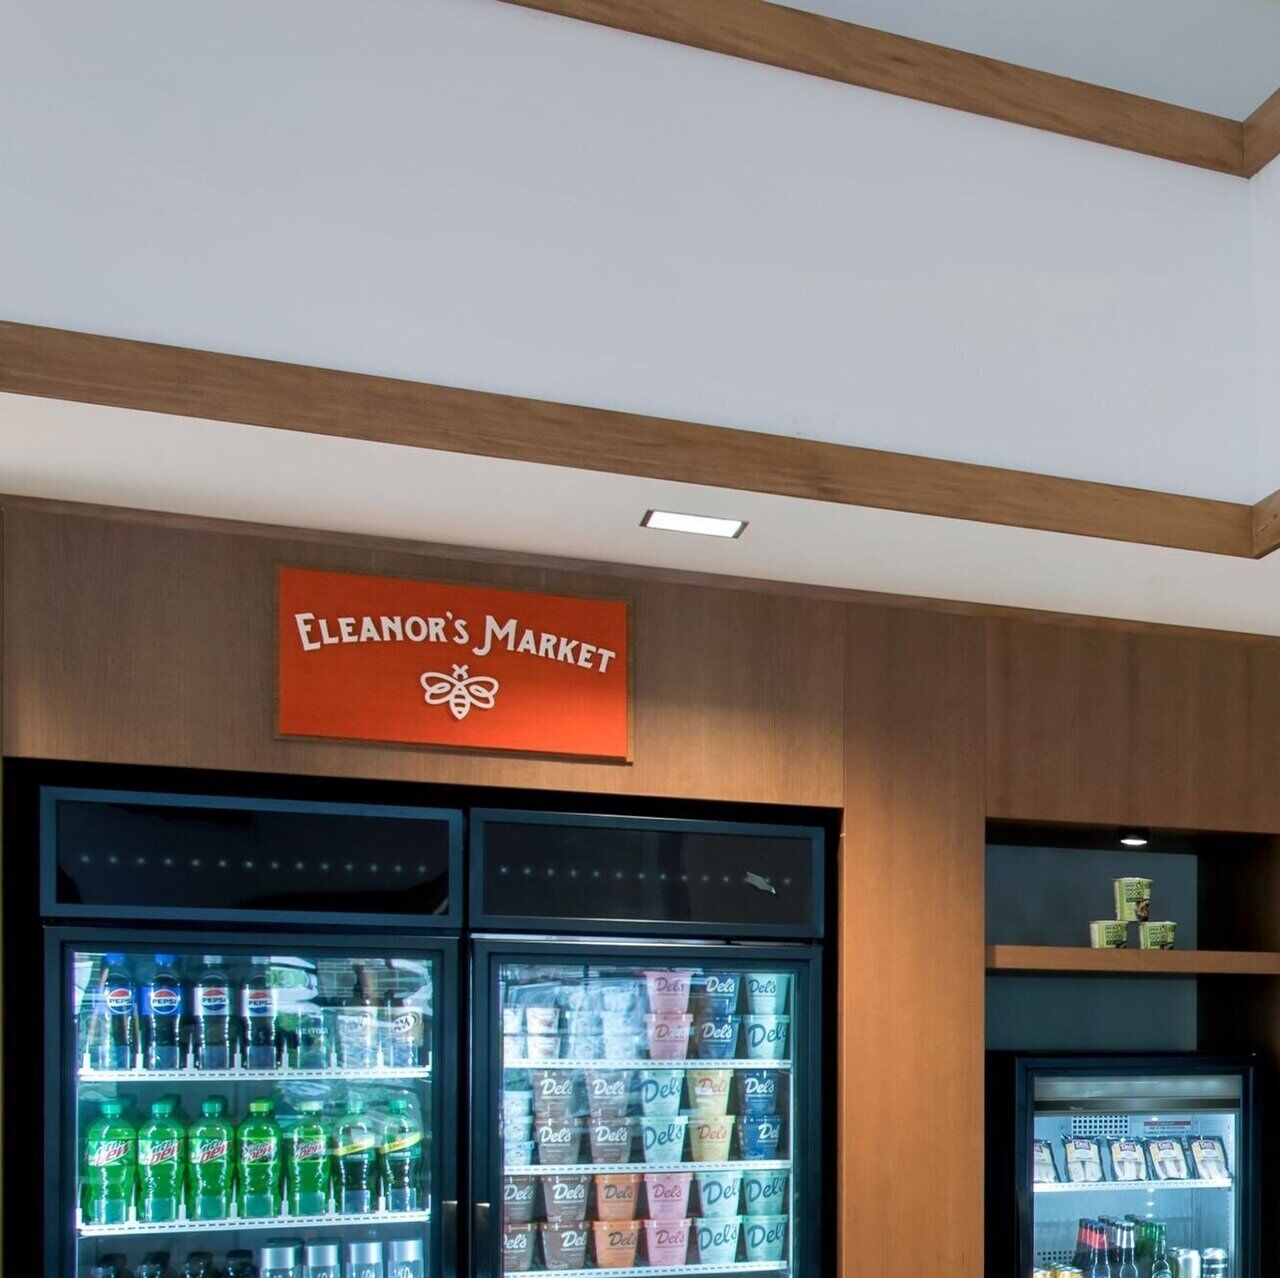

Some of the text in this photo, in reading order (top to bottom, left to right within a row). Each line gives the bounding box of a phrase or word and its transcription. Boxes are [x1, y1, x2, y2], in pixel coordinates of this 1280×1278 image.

[295, 611, 616, 673] ELEANOR'S MARKET
[706, 976, 734, 992] Del's
[702, 1022, 732, 1038] Del's
[593, 1079, 624, 1095] Del's
[745, 1077, 774, 1093] Del's
[540, 1126, 571, 1142] Del's
[595, 1126, 627, 1142] Del's
[643, 1124, 682, 1150] Del's
[698, 1124, 726, 1139] Del's
[552, 1183, 584, 1199] Del's
[653, 1184, 681, 1198] Del's
[504, 1234, 526, 1249] el's
[656, 1230, 684, 1244] Del's
[698, 1224, 737, 1251] Del's
